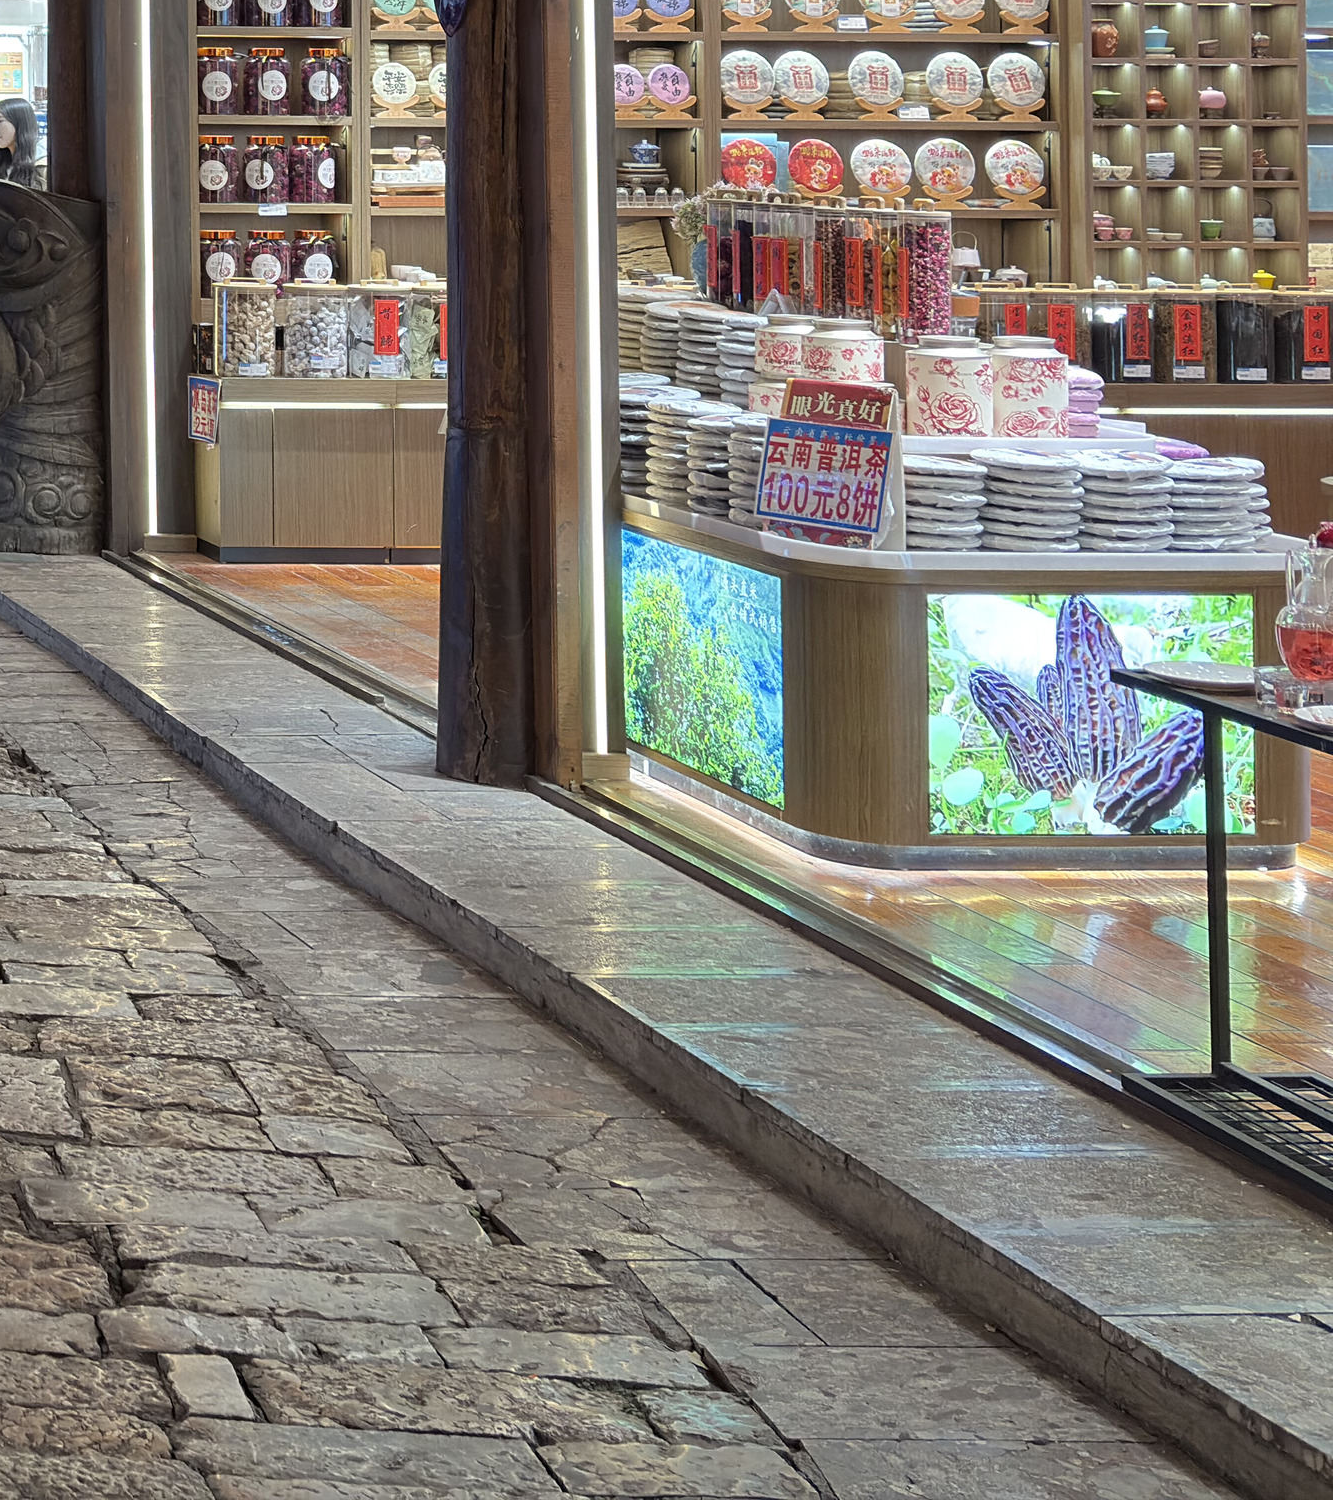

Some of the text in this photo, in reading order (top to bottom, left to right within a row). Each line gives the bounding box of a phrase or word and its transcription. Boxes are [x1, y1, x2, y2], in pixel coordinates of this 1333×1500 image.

[1312, 311, 1324, 356] 中国红
[789, 391, 883, 423] 眼光真好
[767, 431, 890, 480] 云南普洱茶
[764, 471, 880, 527] 100元8饼
